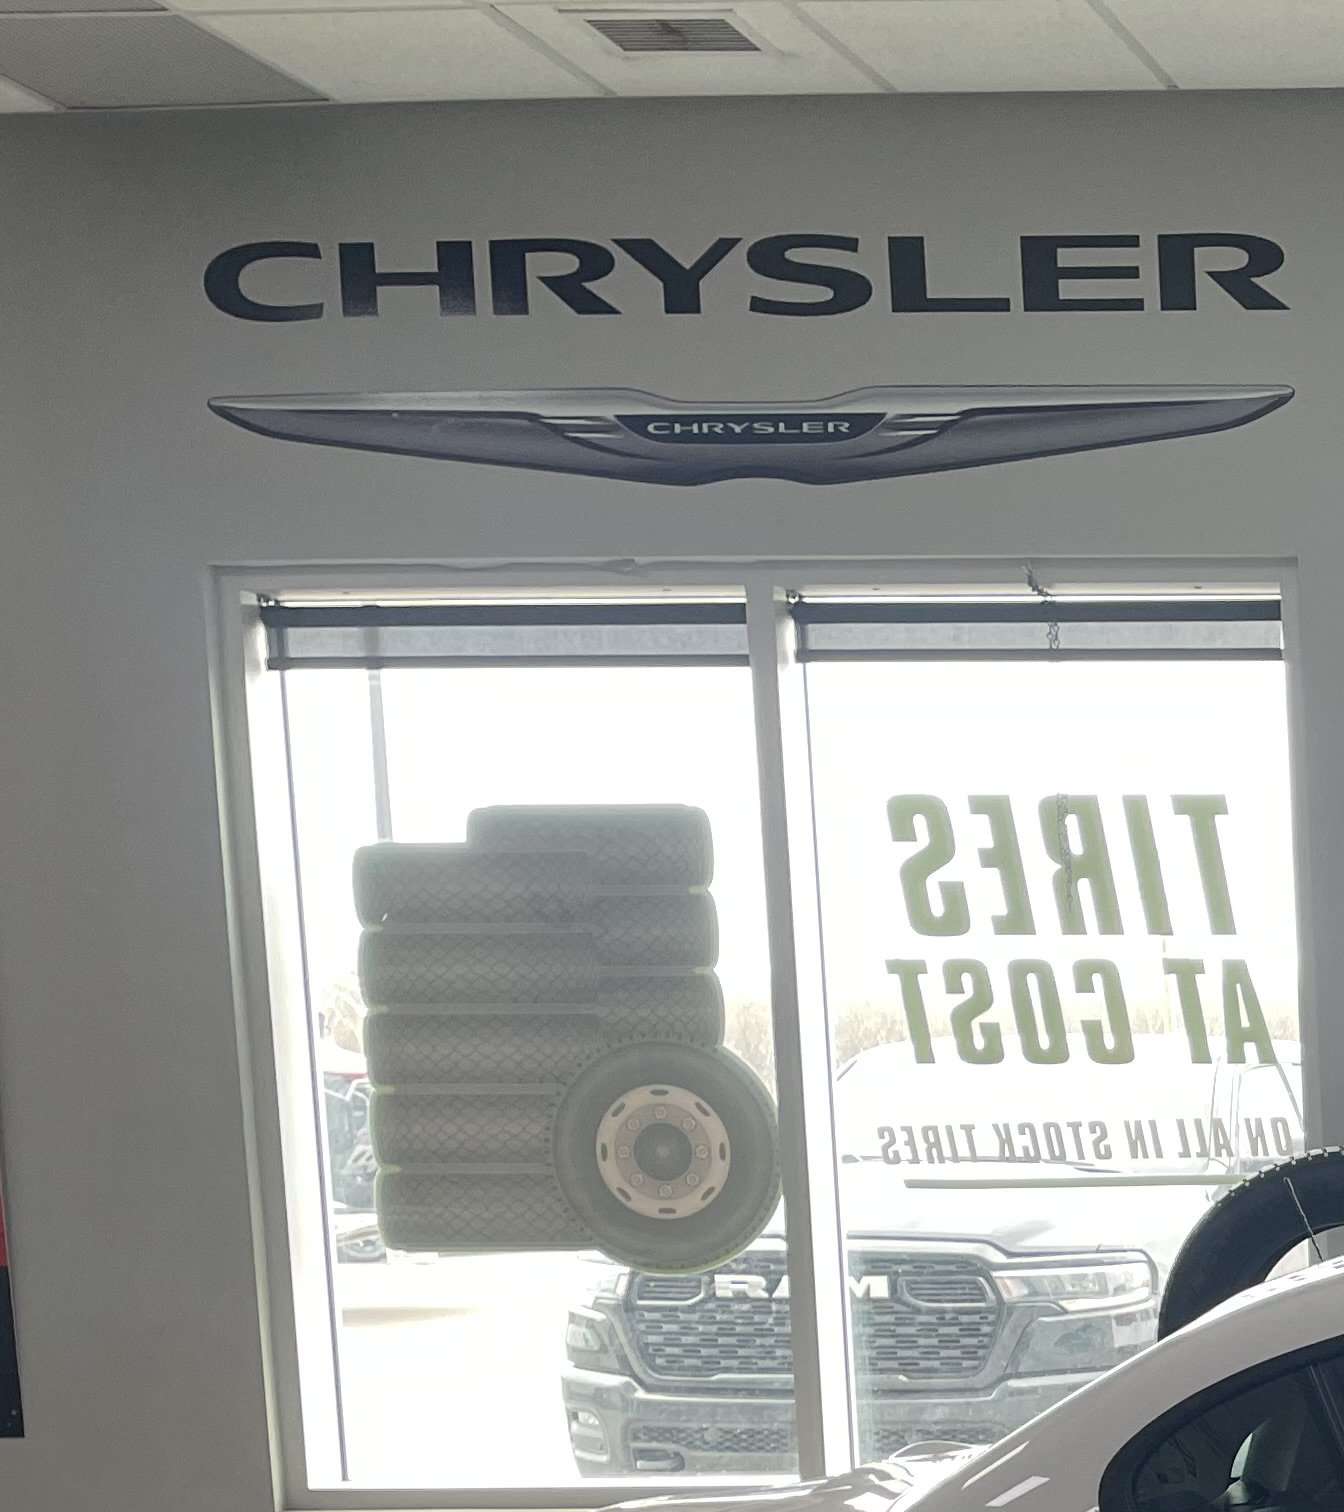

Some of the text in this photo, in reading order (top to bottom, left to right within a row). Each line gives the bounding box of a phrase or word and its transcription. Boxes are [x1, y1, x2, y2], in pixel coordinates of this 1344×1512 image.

[203, 231, 1292, 323] CHRYSLER
[647, 421, 850, 435] CHRYSLER
[714, 1274, 889, 1299] RM
